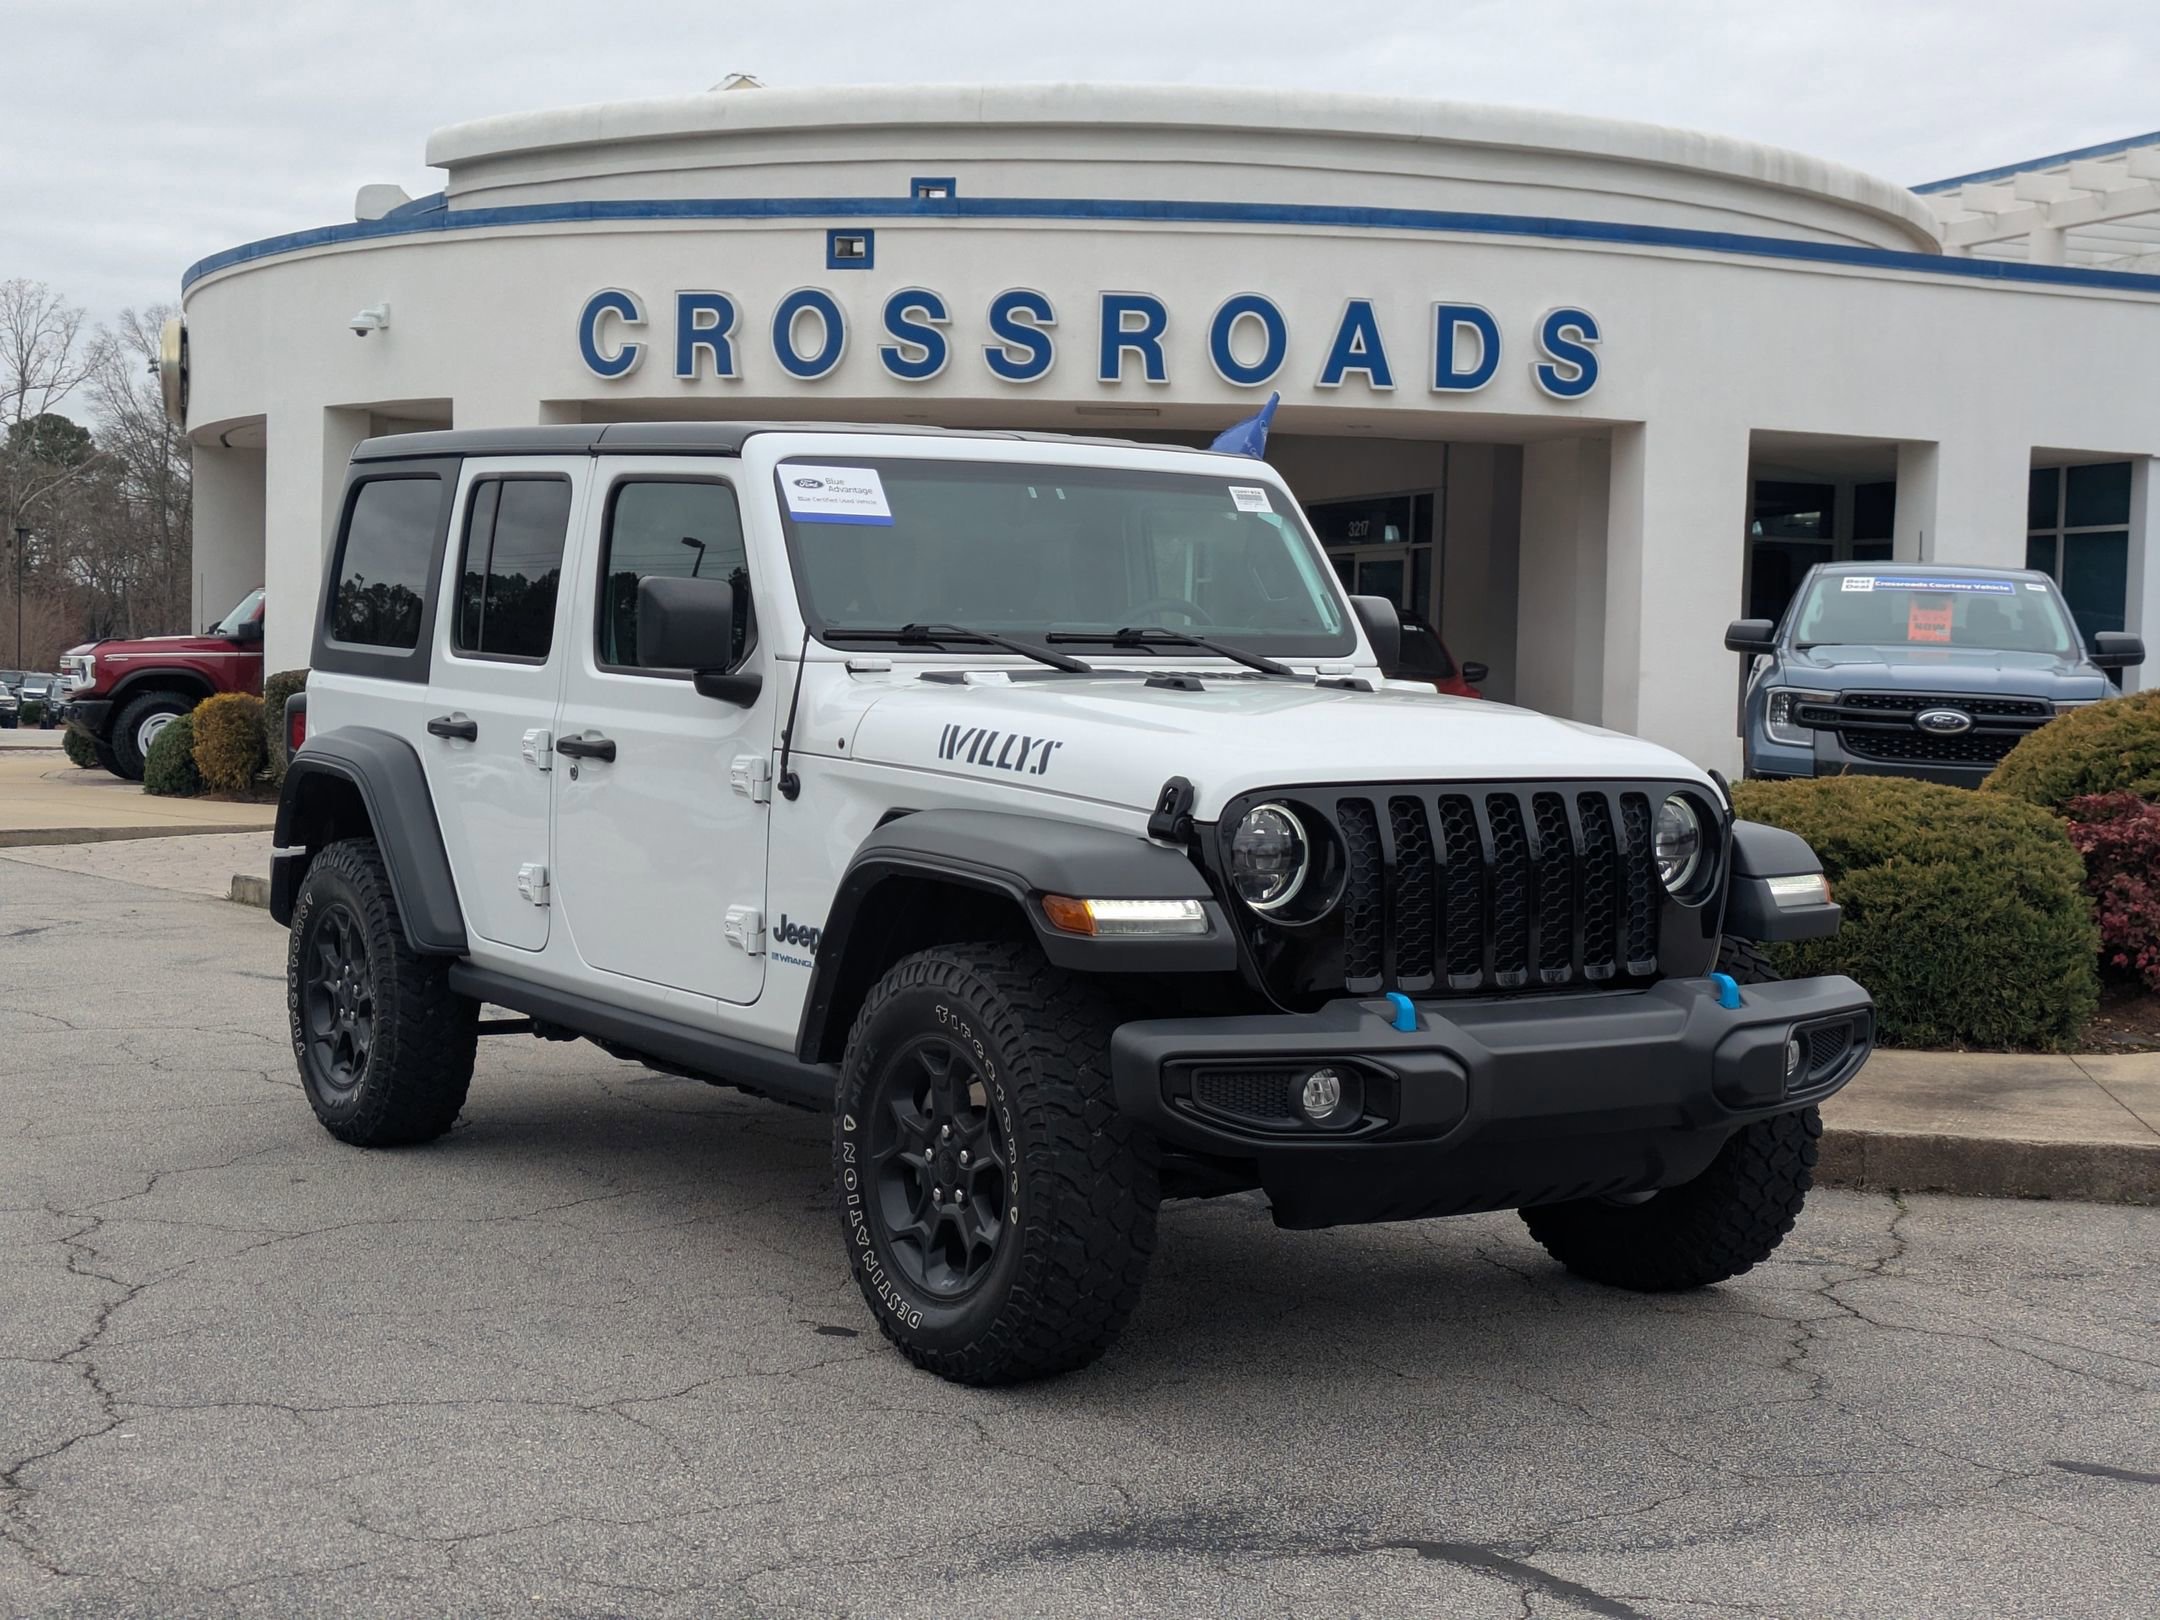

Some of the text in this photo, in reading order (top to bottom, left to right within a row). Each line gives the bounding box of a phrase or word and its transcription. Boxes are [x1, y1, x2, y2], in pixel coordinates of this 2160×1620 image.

[577, 286, 1602, 400] CROSSROADS
[797, 479, 821, 488] Ford
[825, 477, 845, 486] Blue
[828, 485, 873, 496] Advantage
[1348, 520, 1369, 537] 3217
[938, 723, 1064, 775] WILLYS
[773, 914, 821, 955] Jeep
[935, 1003, 1019, 1197] Firestone
[842, 1141, 924, 1330] DESTINATION
